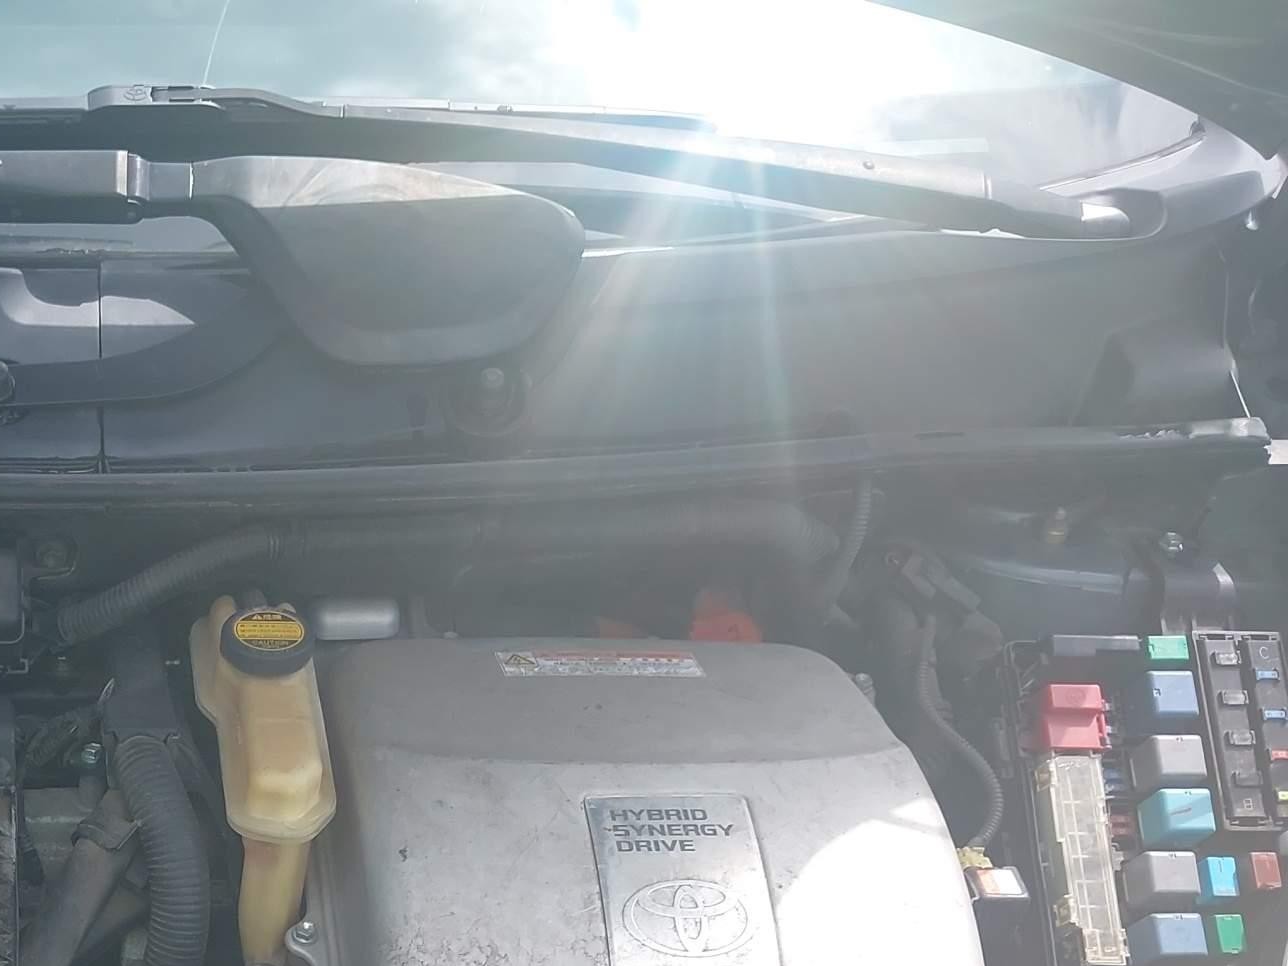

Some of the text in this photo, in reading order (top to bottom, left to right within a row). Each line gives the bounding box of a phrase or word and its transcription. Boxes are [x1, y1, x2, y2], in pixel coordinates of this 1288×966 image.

[609, 808, 708, 822] HYBRID
[612, 823, 734, 837] SYNERGY
[616, 839, 697, 852] DRIVE
